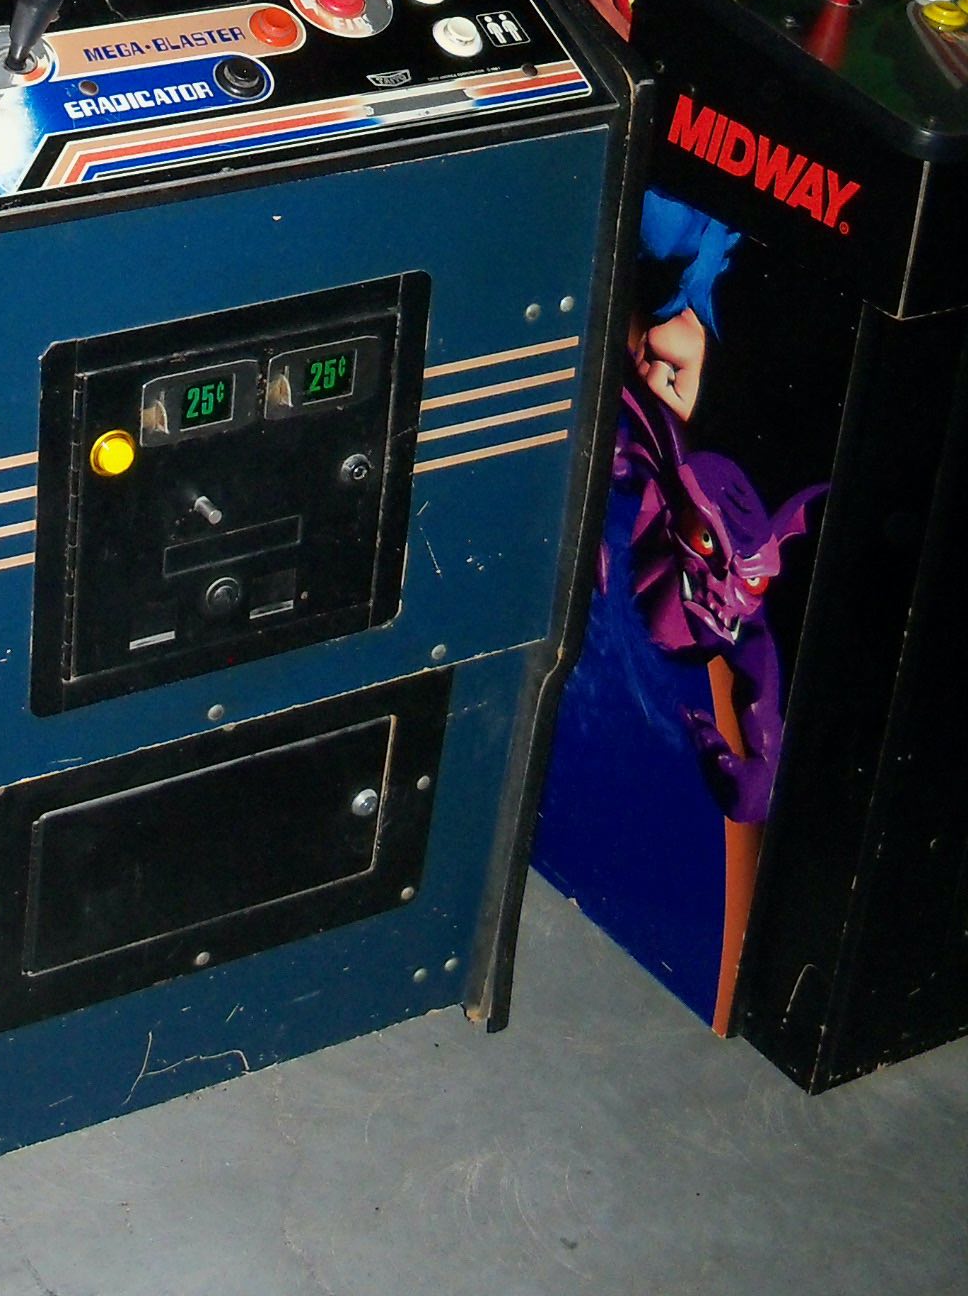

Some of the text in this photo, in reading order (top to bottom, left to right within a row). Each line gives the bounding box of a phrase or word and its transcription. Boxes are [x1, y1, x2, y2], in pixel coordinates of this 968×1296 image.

[375, 74, 407, 85] TAITO
[64, 81, 214, 120] ERADICATOR
[667, 94, 861, 229] MIDWAY
[309, 355, 346, 392] 25¢
[186, 380, 225, 419] 25¢
